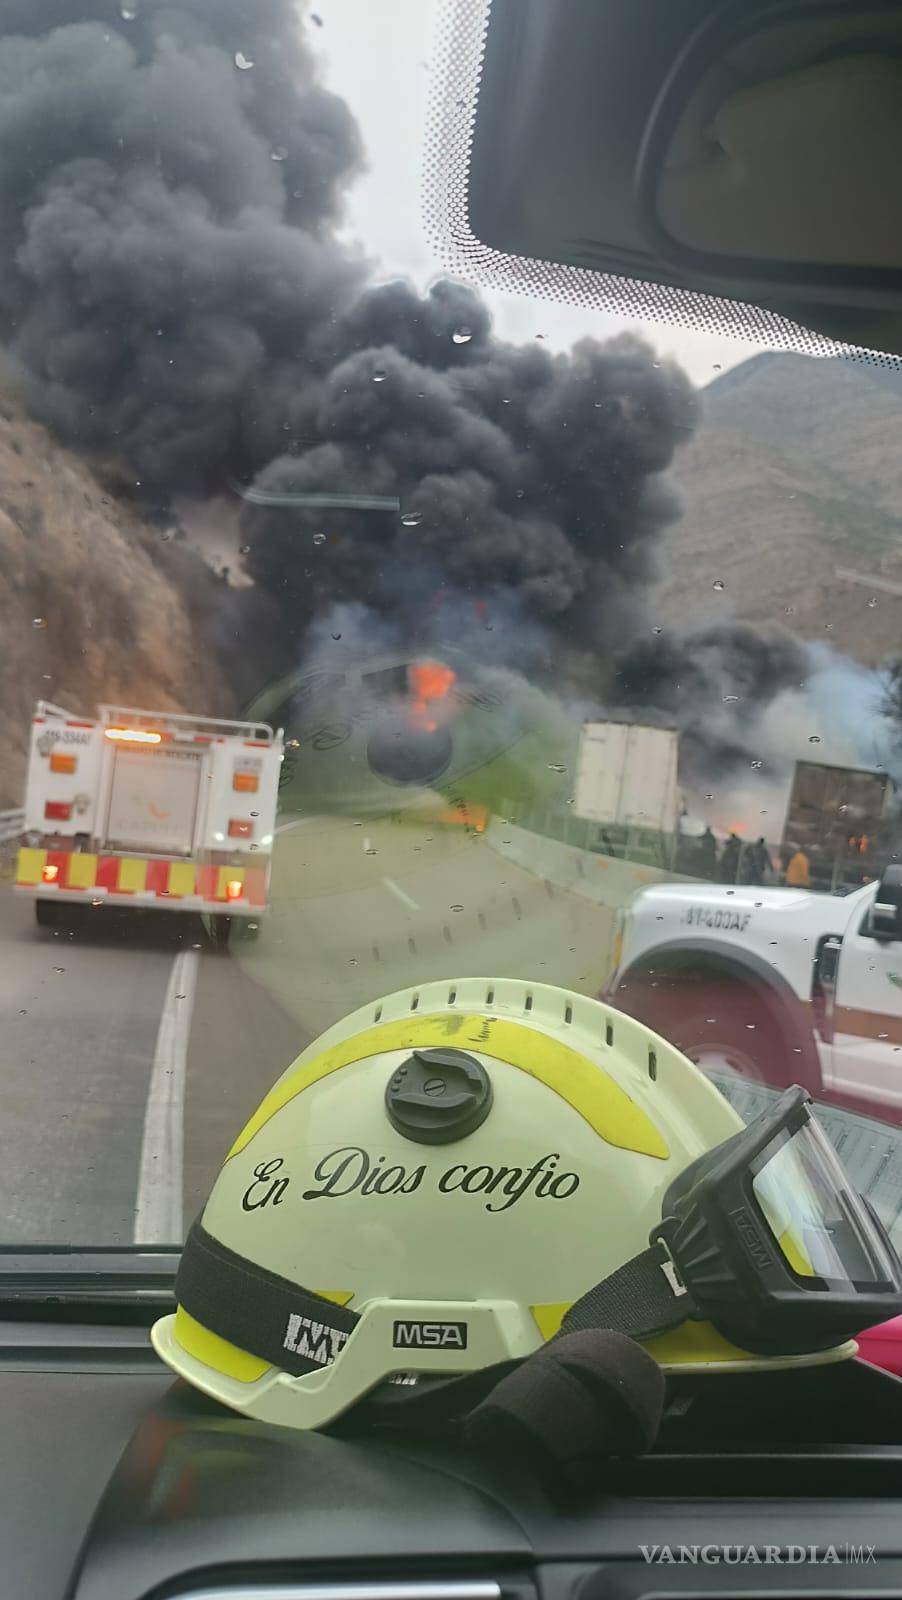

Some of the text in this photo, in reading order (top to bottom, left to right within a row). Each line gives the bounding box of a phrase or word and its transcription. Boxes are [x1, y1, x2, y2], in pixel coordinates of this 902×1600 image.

[242, 1146, 580, 1213] En Dios confio
[395, 1323, 464, 1347] MSA
